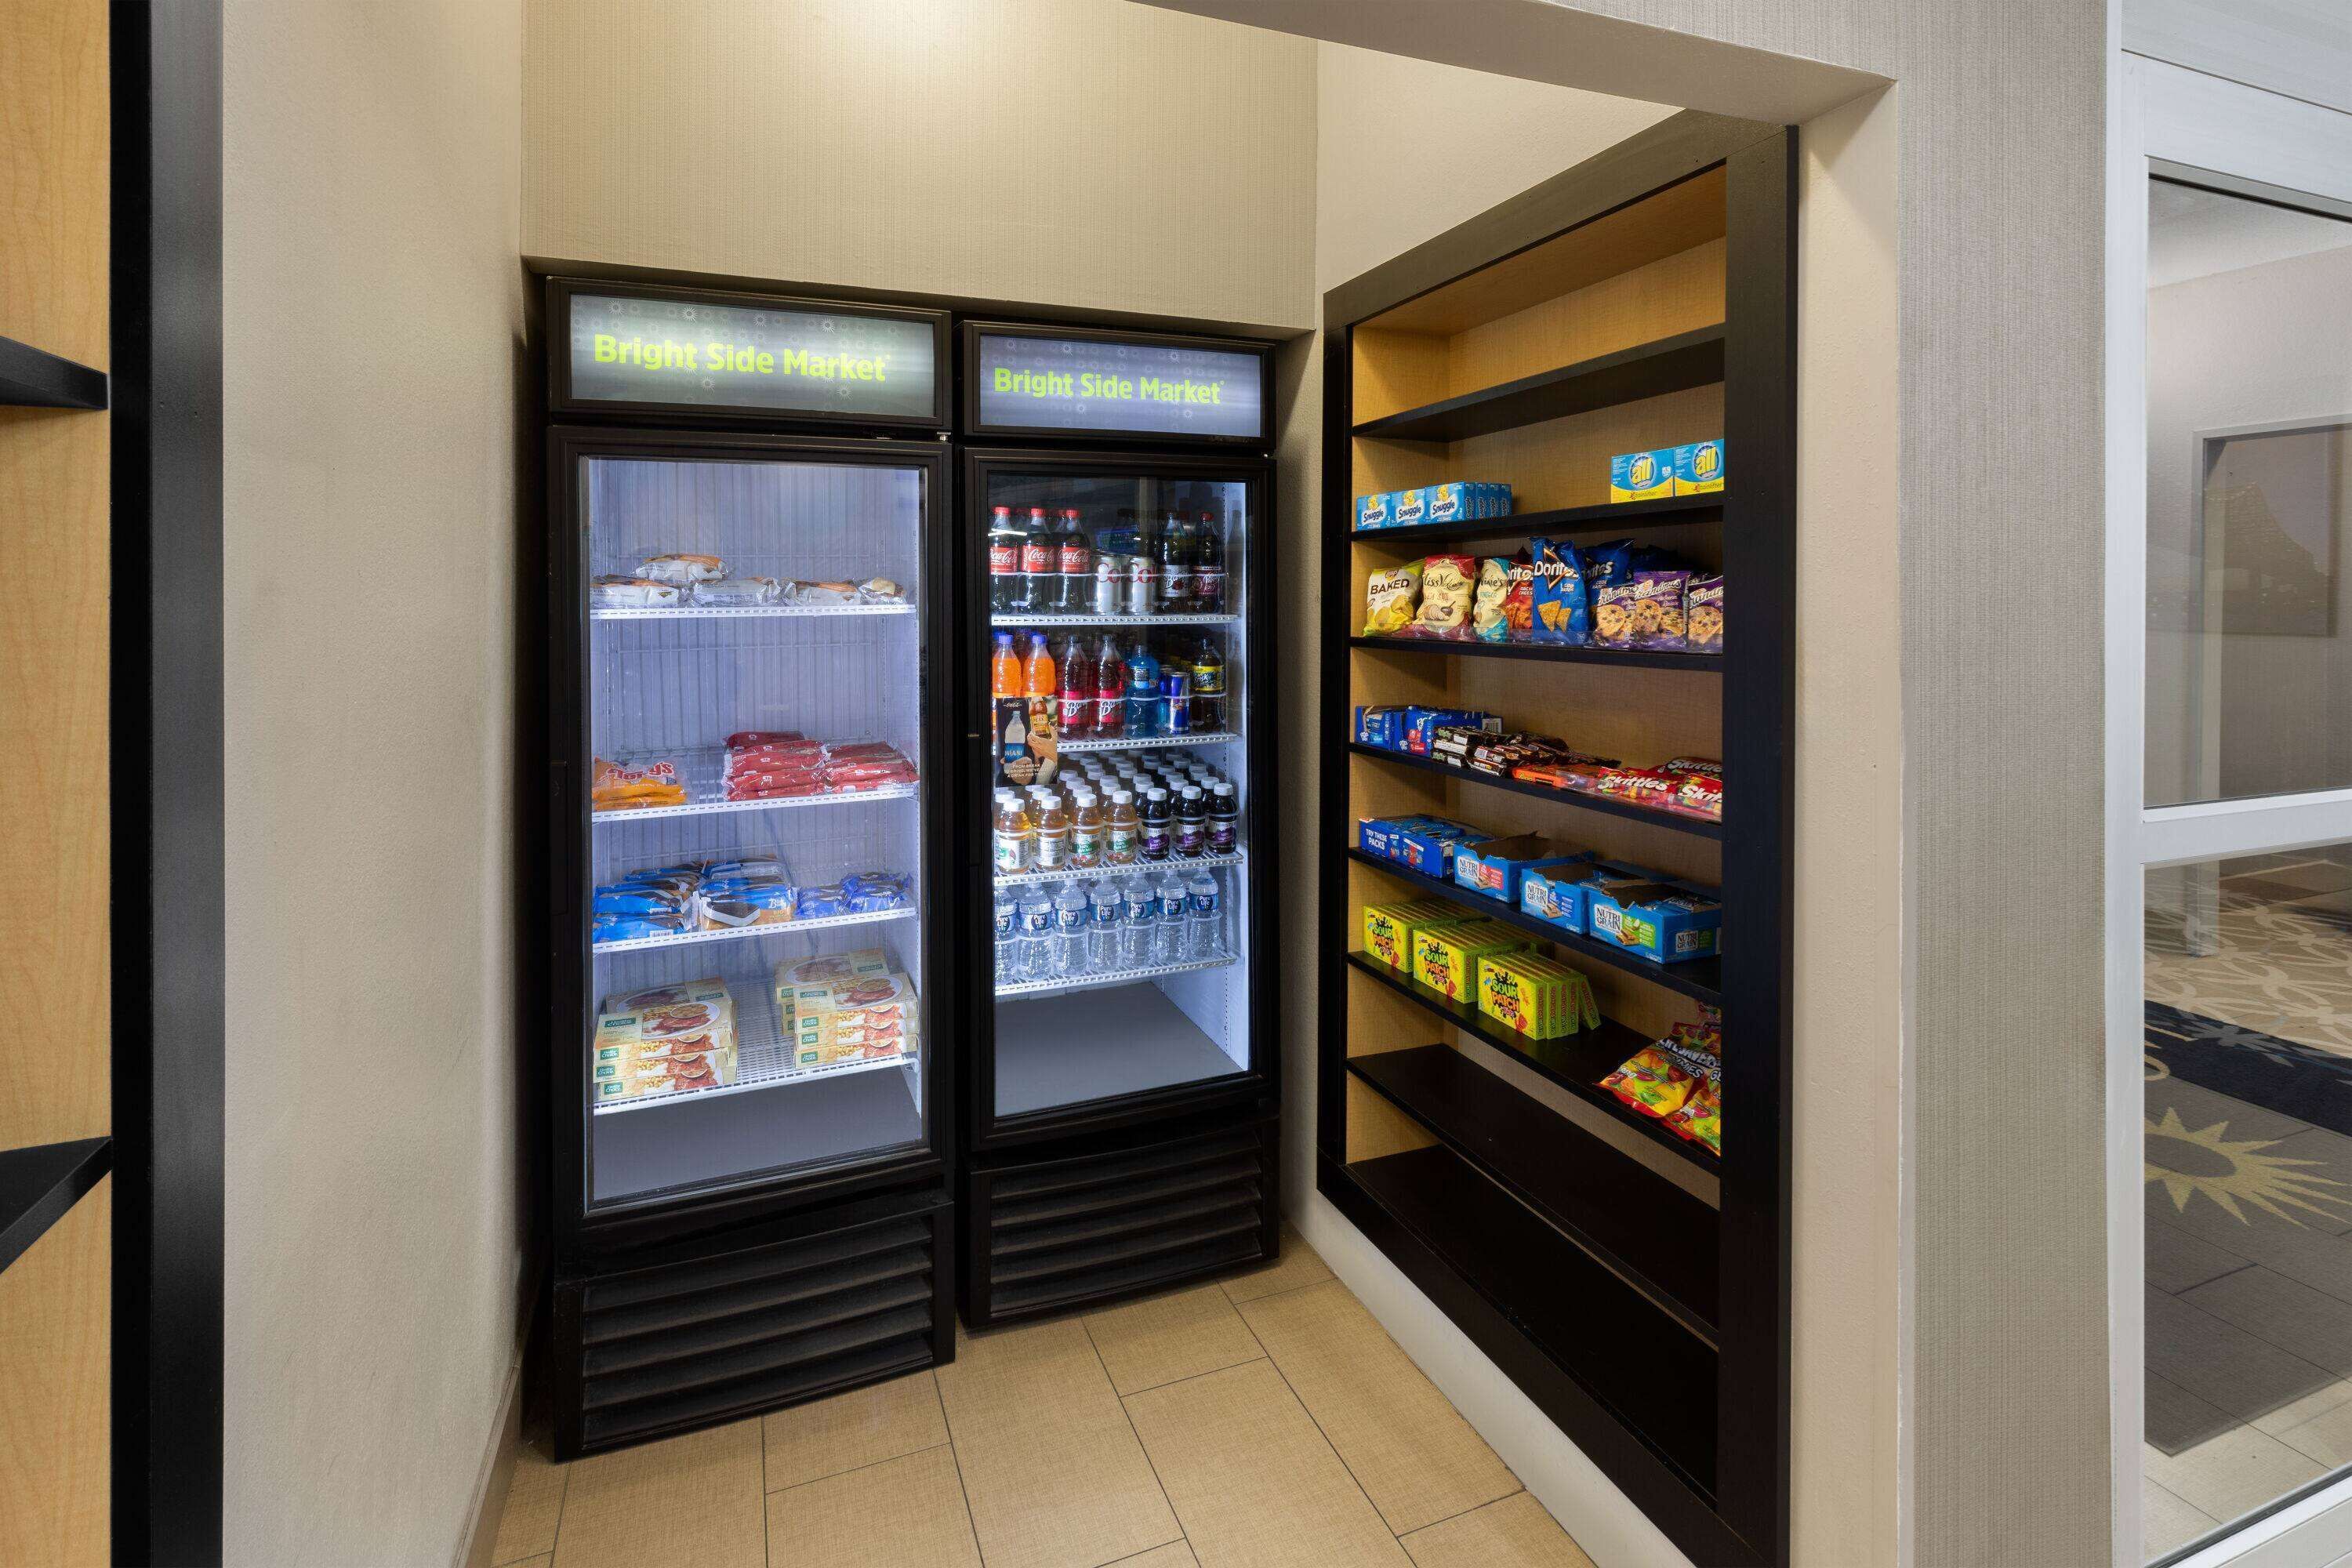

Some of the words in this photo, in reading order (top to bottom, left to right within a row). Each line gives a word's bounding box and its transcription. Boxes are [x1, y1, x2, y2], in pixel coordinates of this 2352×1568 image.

[594, 334, 697, 370] Bright
[707, 343, 774, 374] Side
[784, 350, 886, 381] Market
[995, 368, 1073, 397] Bright
[1080, 374, 1132, 399] Side
[1140, 377, 1221, 404] Market
[1695, 446, 1716, 475] all
[1632, 457, 1652, 485] all
[1398, 505, 1421, 520] Snuggle
[1432, 500, 1455, 514] Snuggle
[1363, 510, 1385, 523] Snuggle
[1534, 561, 1580, 580] Doritos
[1370, 579, 1409, 594] BAKED
[1598, 775, 1668, 791] Skittles
[1368, 837, 1385, 851] PACKS
[1374, 831, 1387, 842] THESE
[1459, 858, 1478, 870] NUTRI
[1459, 866, 1479, 877] GRAIN
[1527, 884, 1546, 897] NUTRI
[1527, 892, 1547, 906] GRAIN
[1596, 907, 1621, 922] NUTRI
[1596, 916, 1621, 931] GRAIN
[1374, 926, 1393, 939] SOUR
[1373, 935, 1394, 951] PATCH
[1425, 952, 1448, 967] SOUR
[1425, 960, 1450, 979] PATCH
[1491, 978, 1518, 997] SOUR
[1491, 991, 1519, 1012] PATCH
